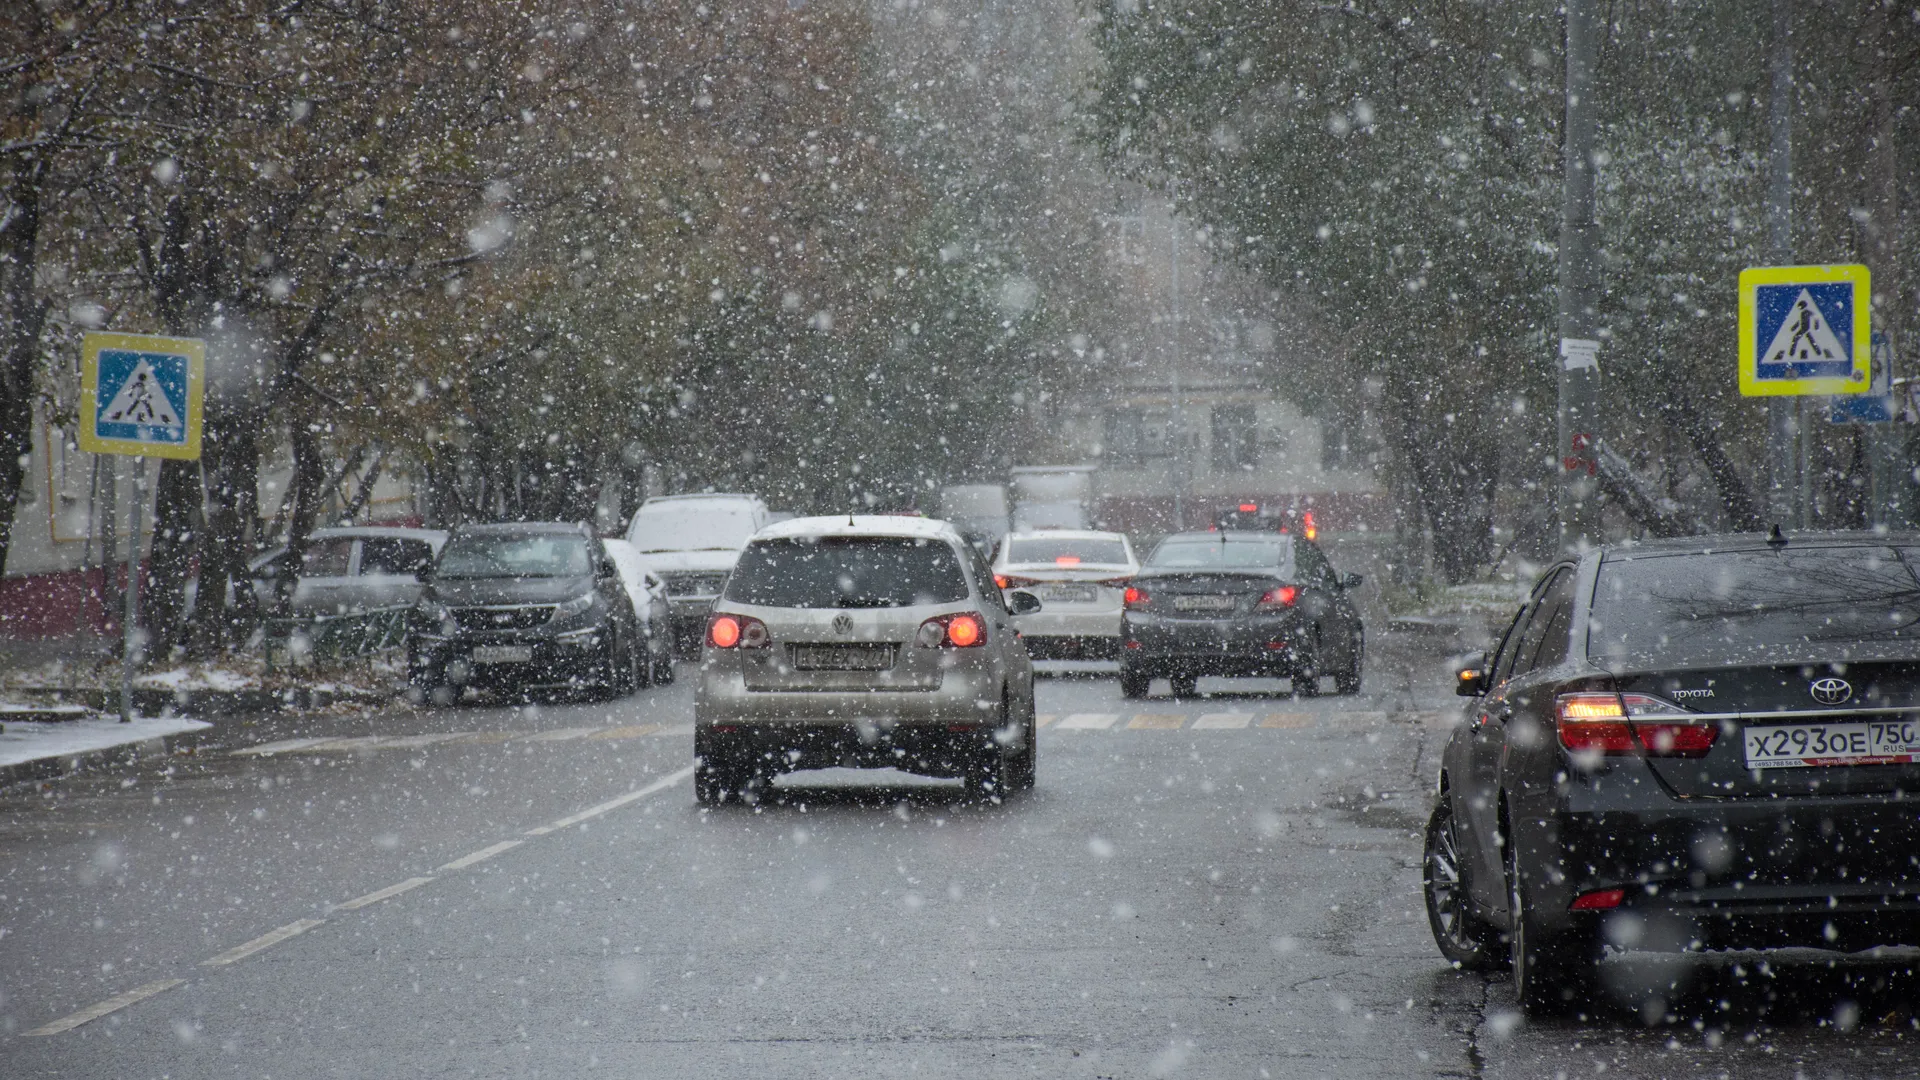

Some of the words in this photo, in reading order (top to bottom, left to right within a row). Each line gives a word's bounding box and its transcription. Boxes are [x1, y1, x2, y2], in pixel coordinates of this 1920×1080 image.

[1672, 689, 1715, 698] TOYOTA
[1871, 723, 1915, 744] 750
[1883, 744, 1905, 752] RUS
